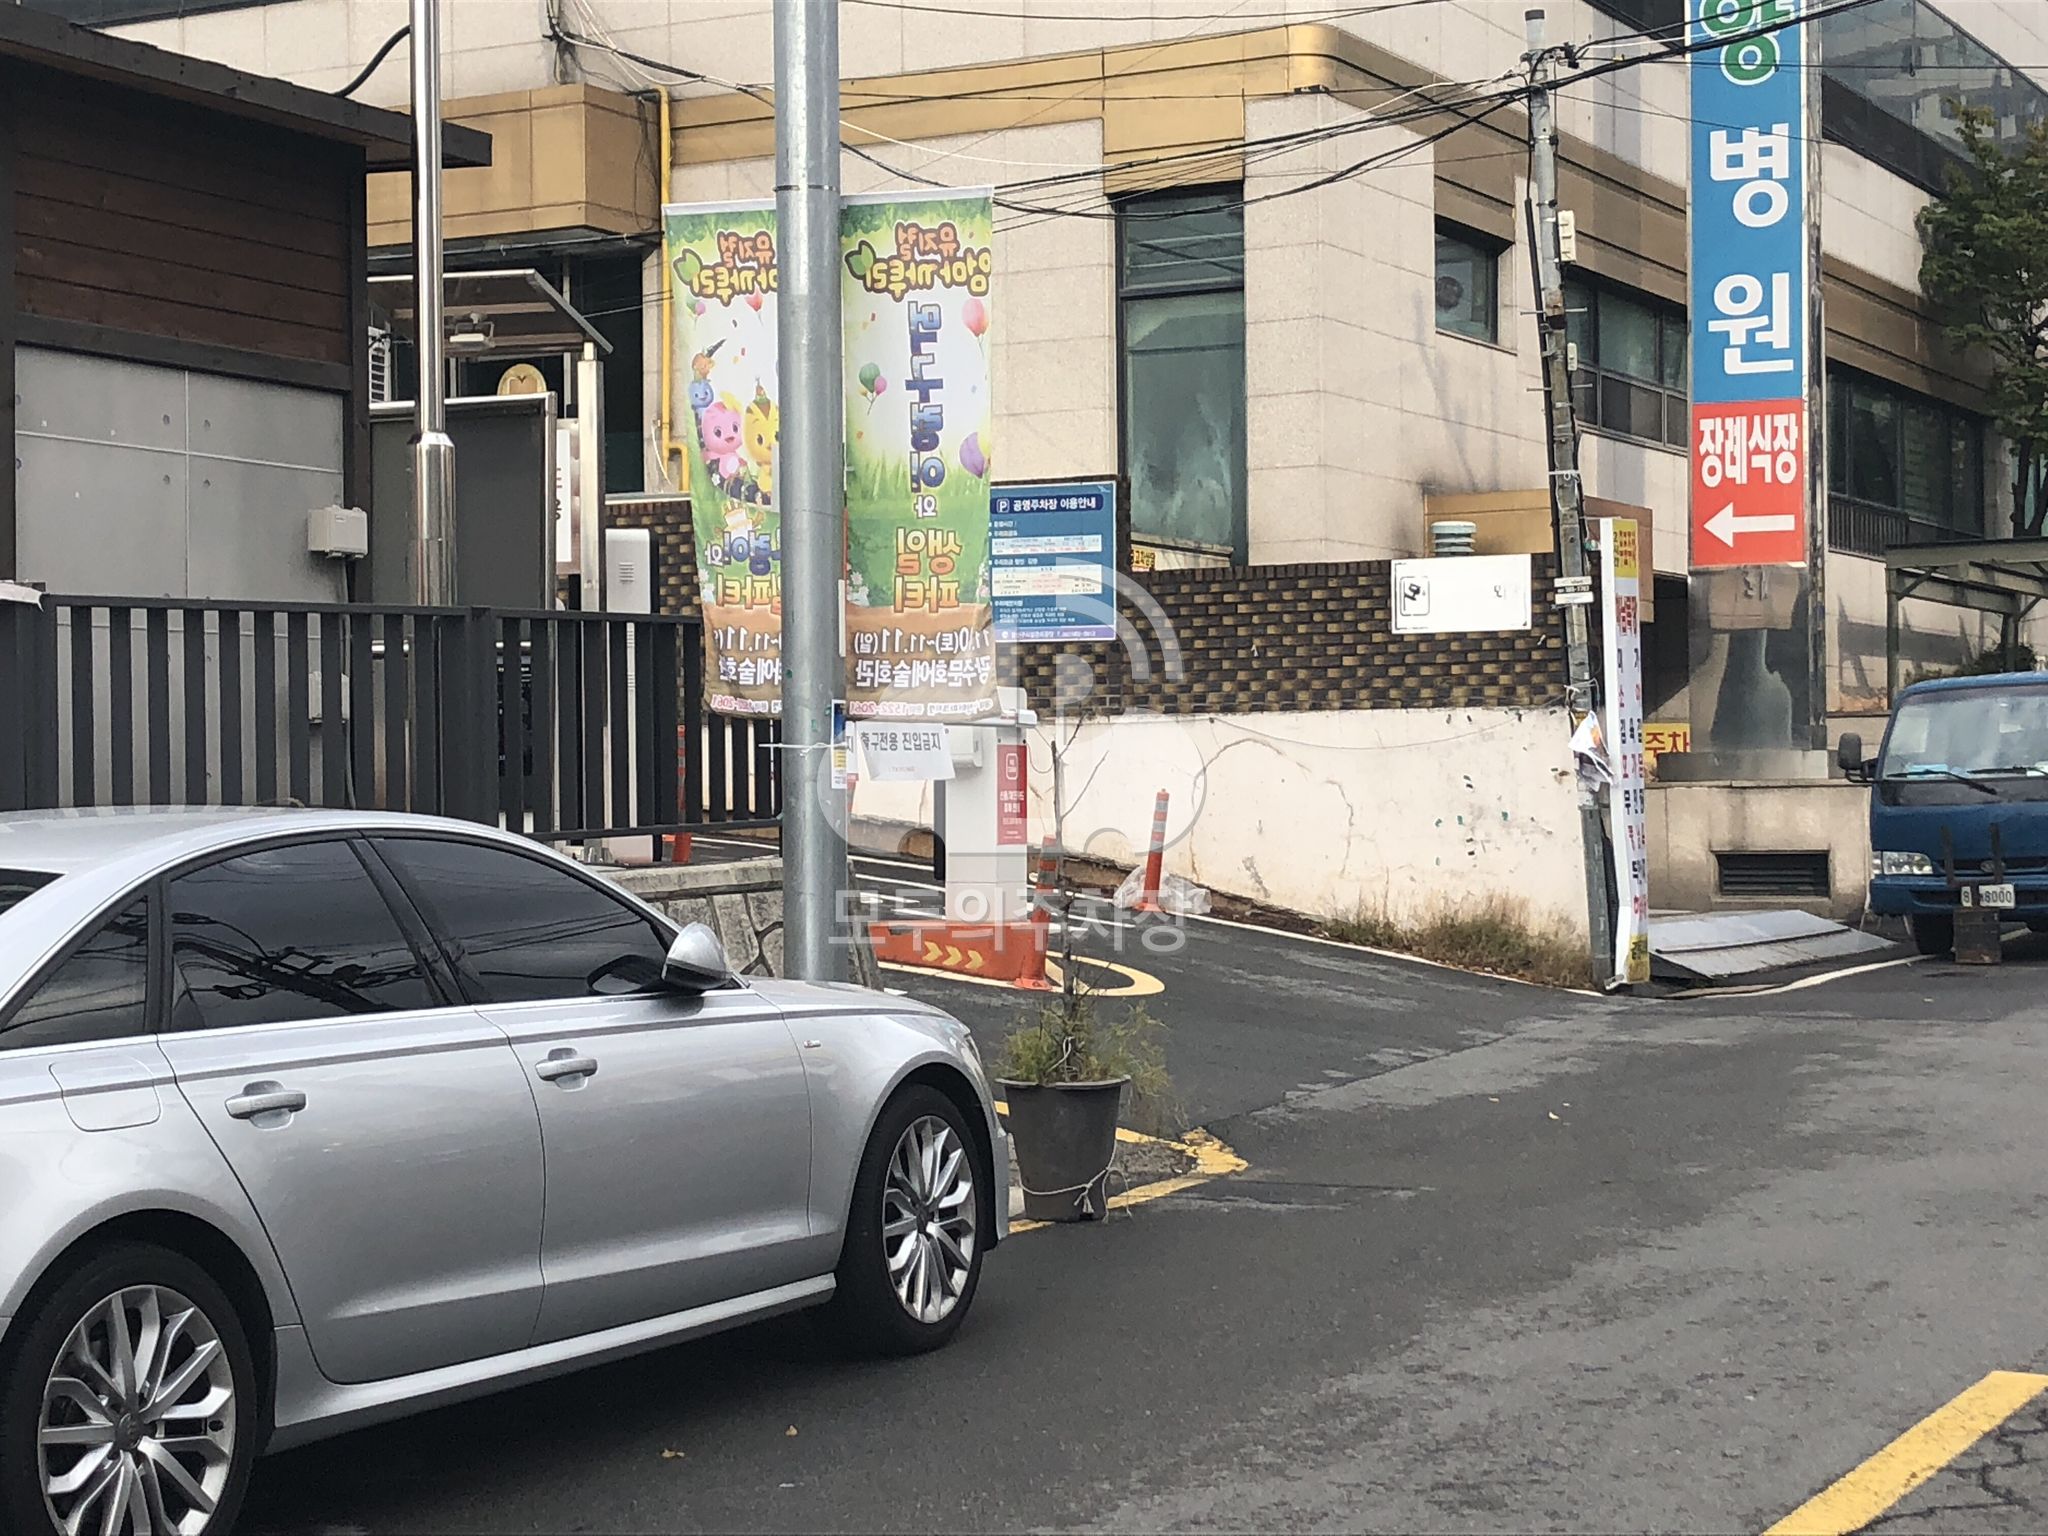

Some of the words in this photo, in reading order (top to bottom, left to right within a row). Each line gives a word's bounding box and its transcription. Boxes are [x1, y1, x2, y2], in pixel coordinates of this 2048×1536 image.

[1699, 413, 1798, 487] 장례식장
[1013, 499, 1058, 512] 공영주차장
[1060, 497, 1096, 510] 이용안내
[902, 732, 941, 751] 진입금지
